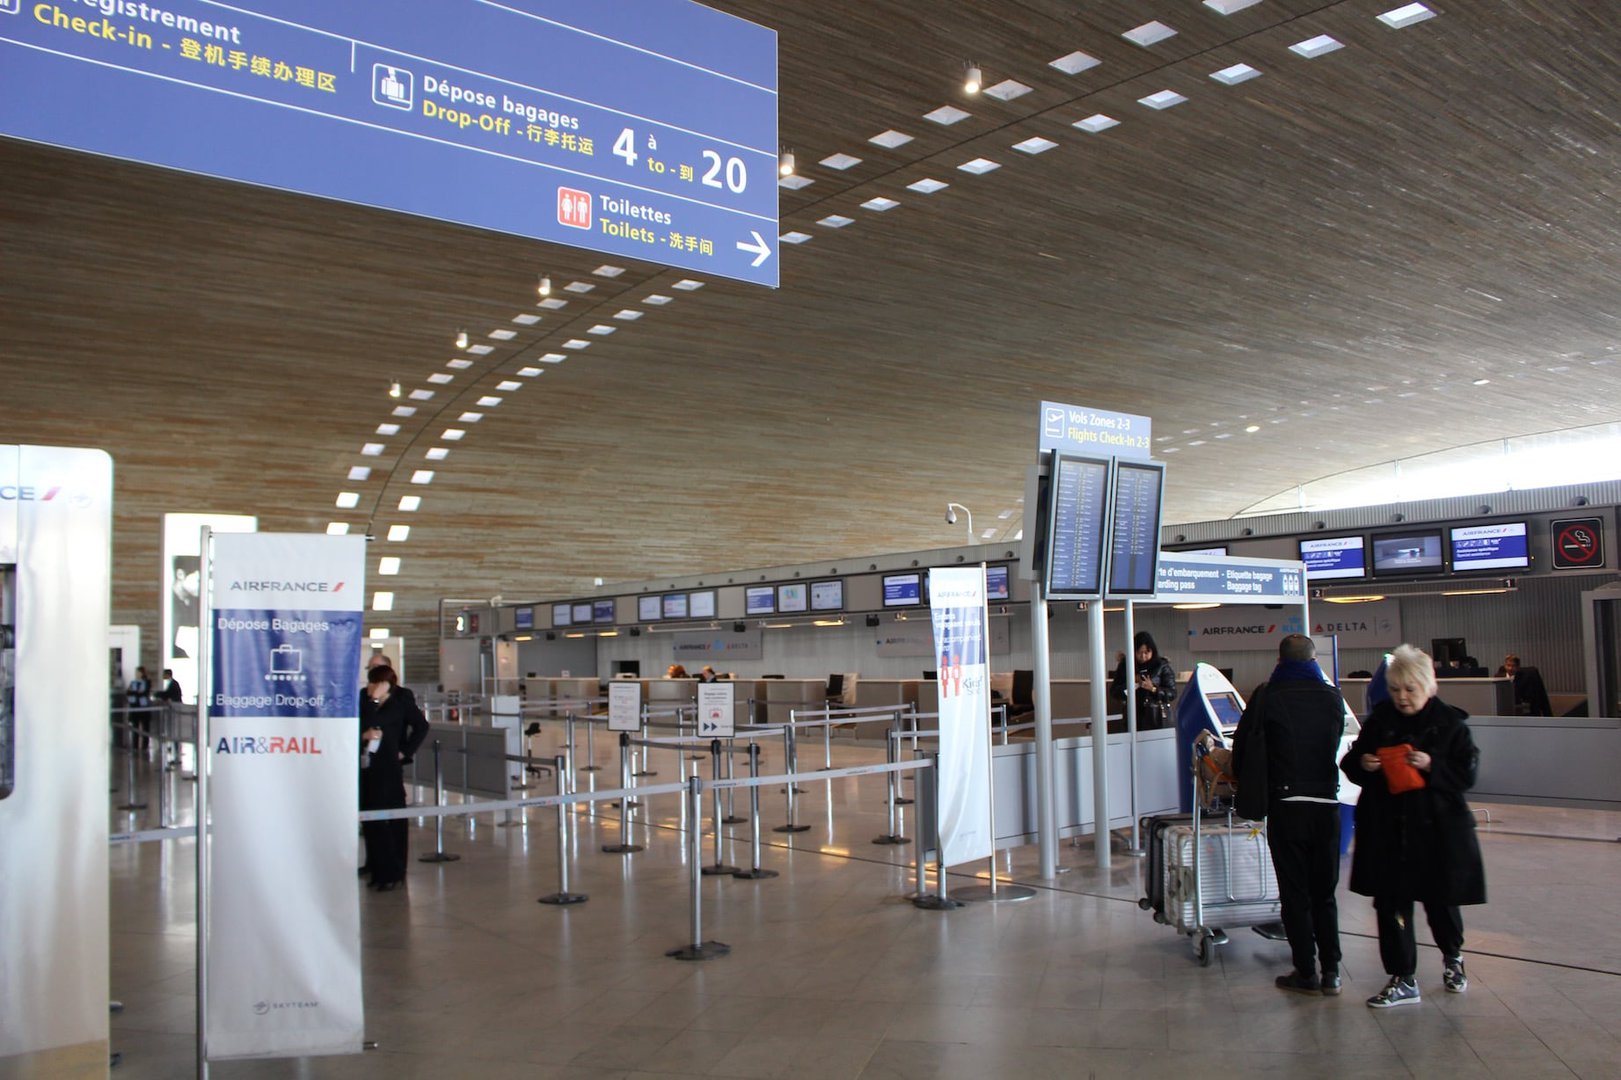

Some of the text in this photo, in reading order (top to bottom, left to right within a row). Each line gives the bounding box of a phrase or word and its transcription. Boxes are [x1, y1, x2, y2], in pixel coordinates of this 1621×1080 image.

[33, 3, 153, 50] Check-in
[180, 37, 337, 93] 登机手续办理区
[423, 75, 579, 130] Dépose bagages
[422, 99, 511, 136] Drop-Off
[526, 123, 594, 156] 行李托运
[612, 127, 747, 194] 4 à 20
[646, 157, 665, 174] to
[679, 163, 694, 183] 到
[599, 194, 672, 225] Toilettes
[599, 217, 655, 244] Toilets
[669, 231, 713, 257] 洗手间
[1068, 410, 1131, 430] Vols Zones 2-3
[1067, 426, 1097, 444] Flights
[1136, 436, 1150, 449] 2-3
[230, 581, 329, 593] AIRFRANCE
[1179, 581, 1196, 591] pass
[1226, 581, 1252, 593] Baggage
[217, 617, 330, 635] Dépose Bagages
[1202, 625, 1265, 636] AIRFRANCE
[1326, 622, 1368, 631] DELTA
[215, 694, 325, 709] Baggage Drop-off
[215, 737, 322, 755] AIR&RAIL
